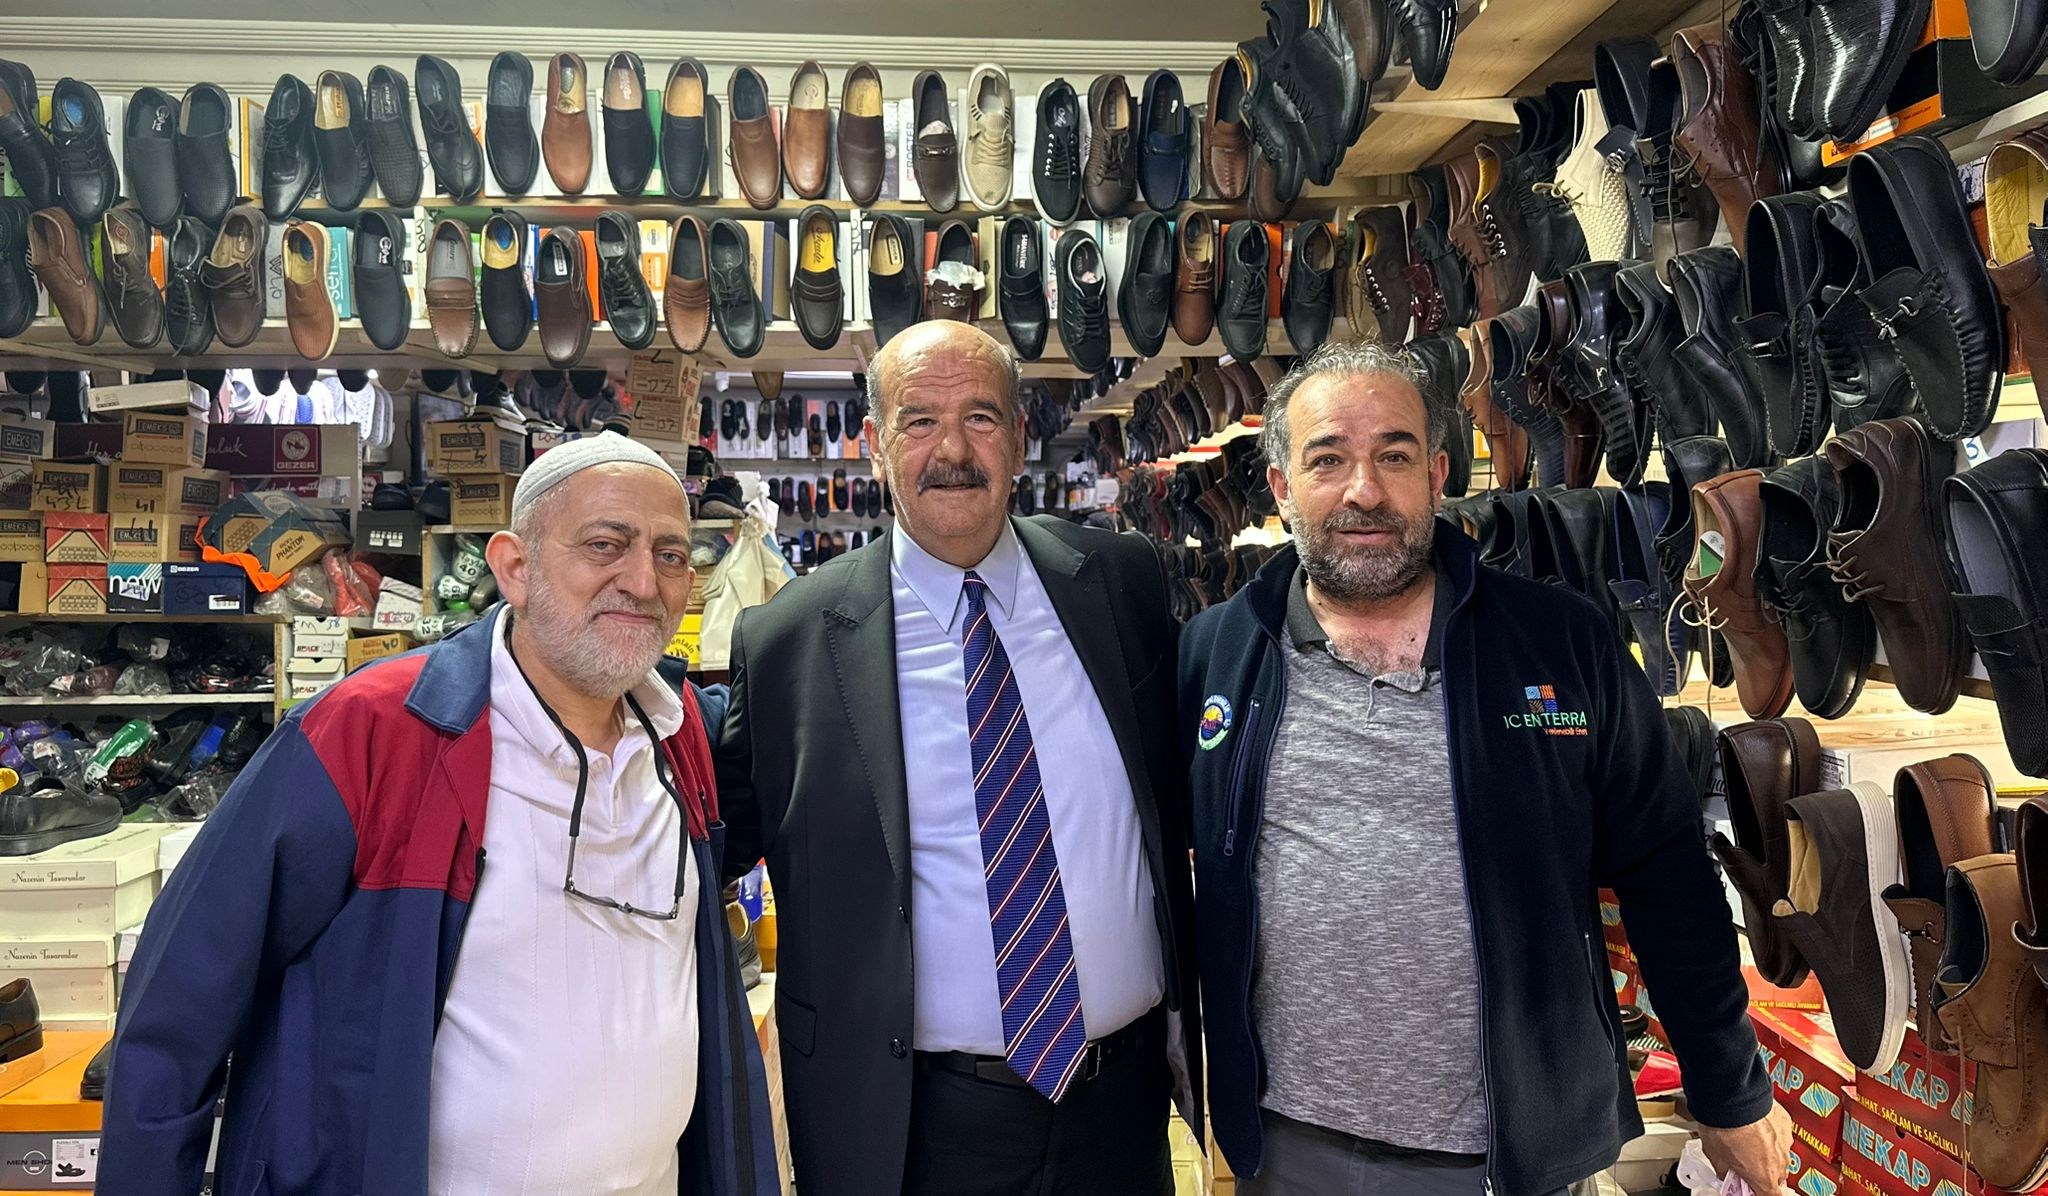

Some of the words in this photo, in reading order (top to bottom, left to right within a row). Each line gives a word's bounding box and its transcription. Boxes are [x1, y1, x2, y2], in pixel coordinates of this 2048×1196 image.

[6, 432, 31, 448] EMEKS
[276, 461, 315, 469] GEZER
[459, 564, 477, 576] 40
[109, 575, 162, 594] new
[421, 617, 432, 635] 32
[1523, 711, 1588, 728] ENTERRA
[1757, 1042, 1804, 1094] KAP
[1881, 1103, 1912, 1132] SAĞLAM
[1913, 1123, 1923, 1138] VE
[1923, 1127, 1959, 1158] SAĞLIKLI
[1797, 1125, 1831, 1158] AYAKKABI
[1842, 1110, 1931, 1192] MEKAP
